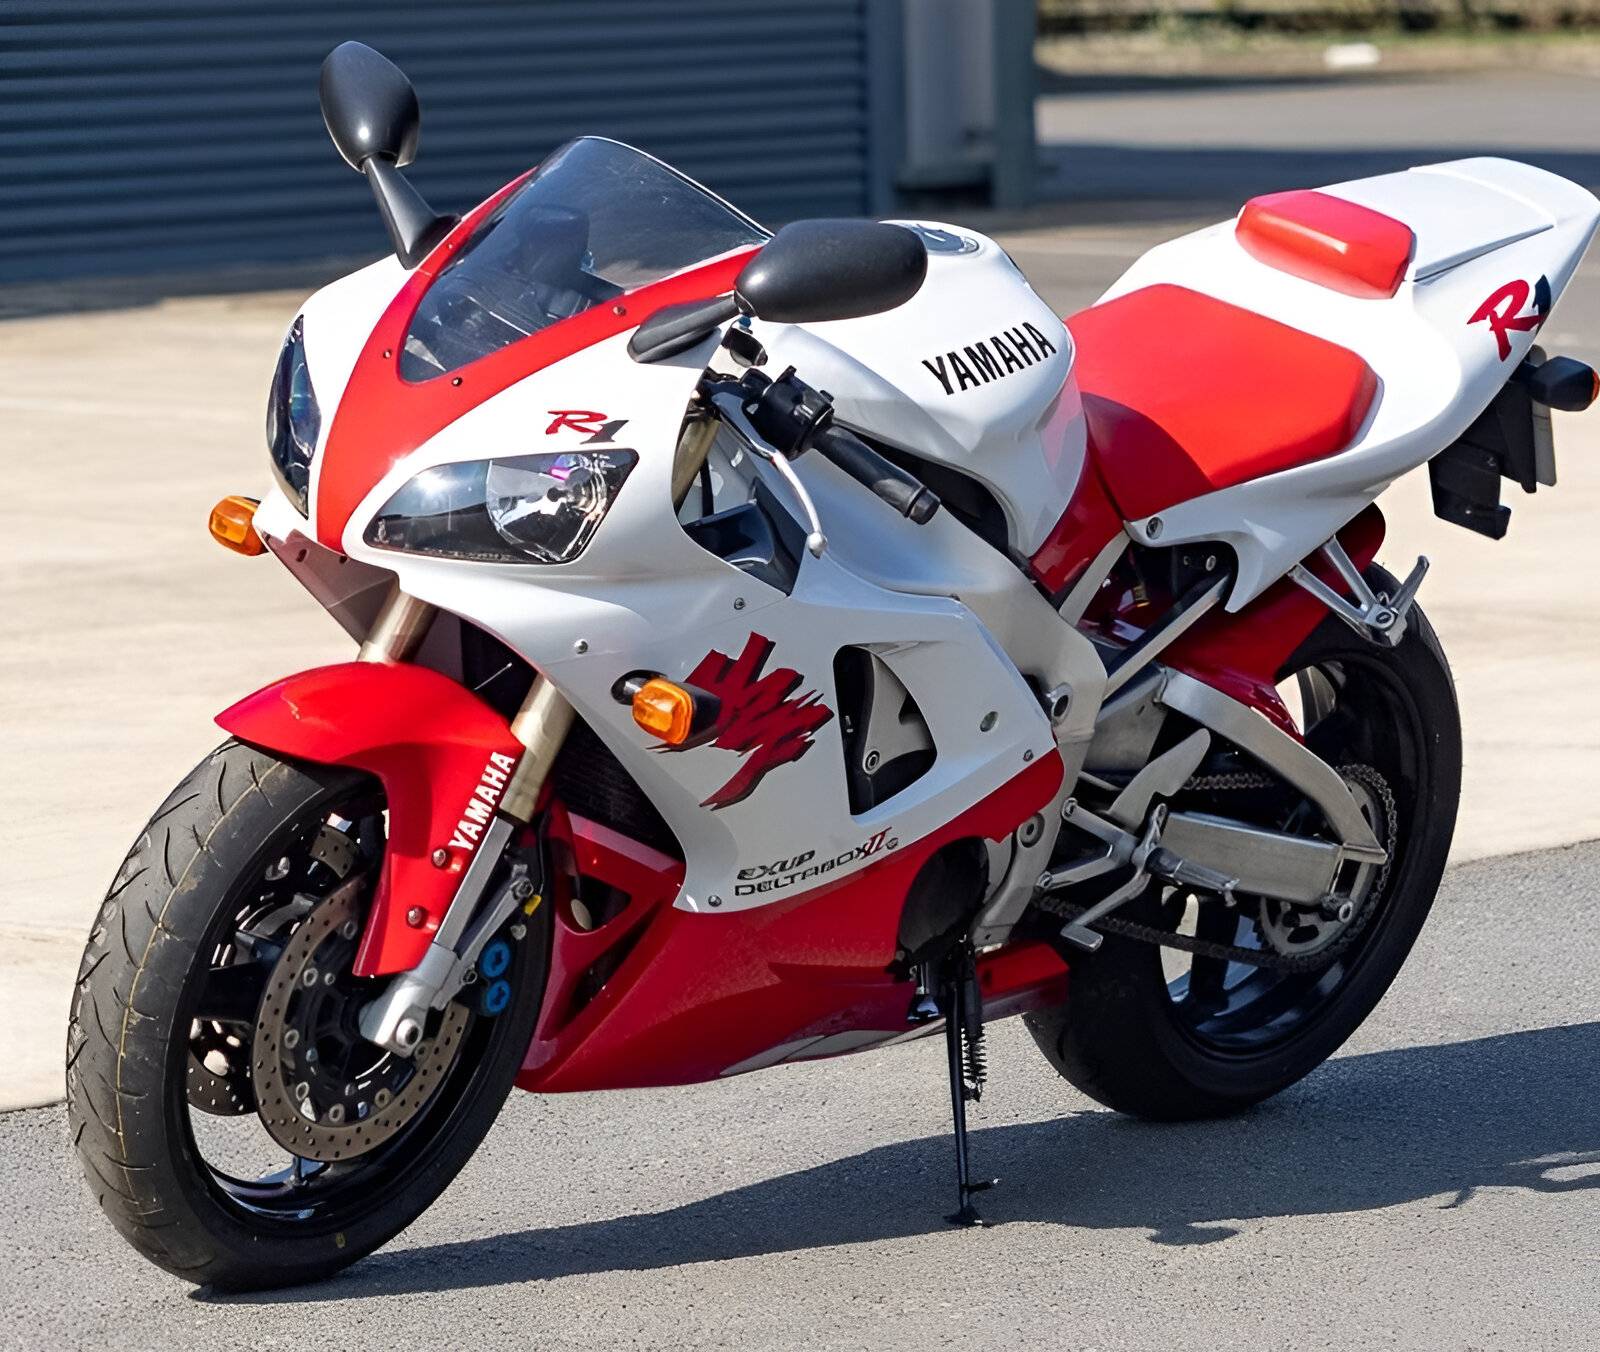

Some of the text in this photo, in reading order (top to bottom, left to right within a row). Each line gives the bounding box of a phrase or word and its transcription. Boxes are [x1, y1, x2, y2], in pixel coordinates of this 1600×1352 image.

[921, 322, 1057, 395] YAMAHA
[545, 410, 630, 445] R1
[447, 751, 516, 851] YAMAHA
[736, 850, 816, 881] EXUP
